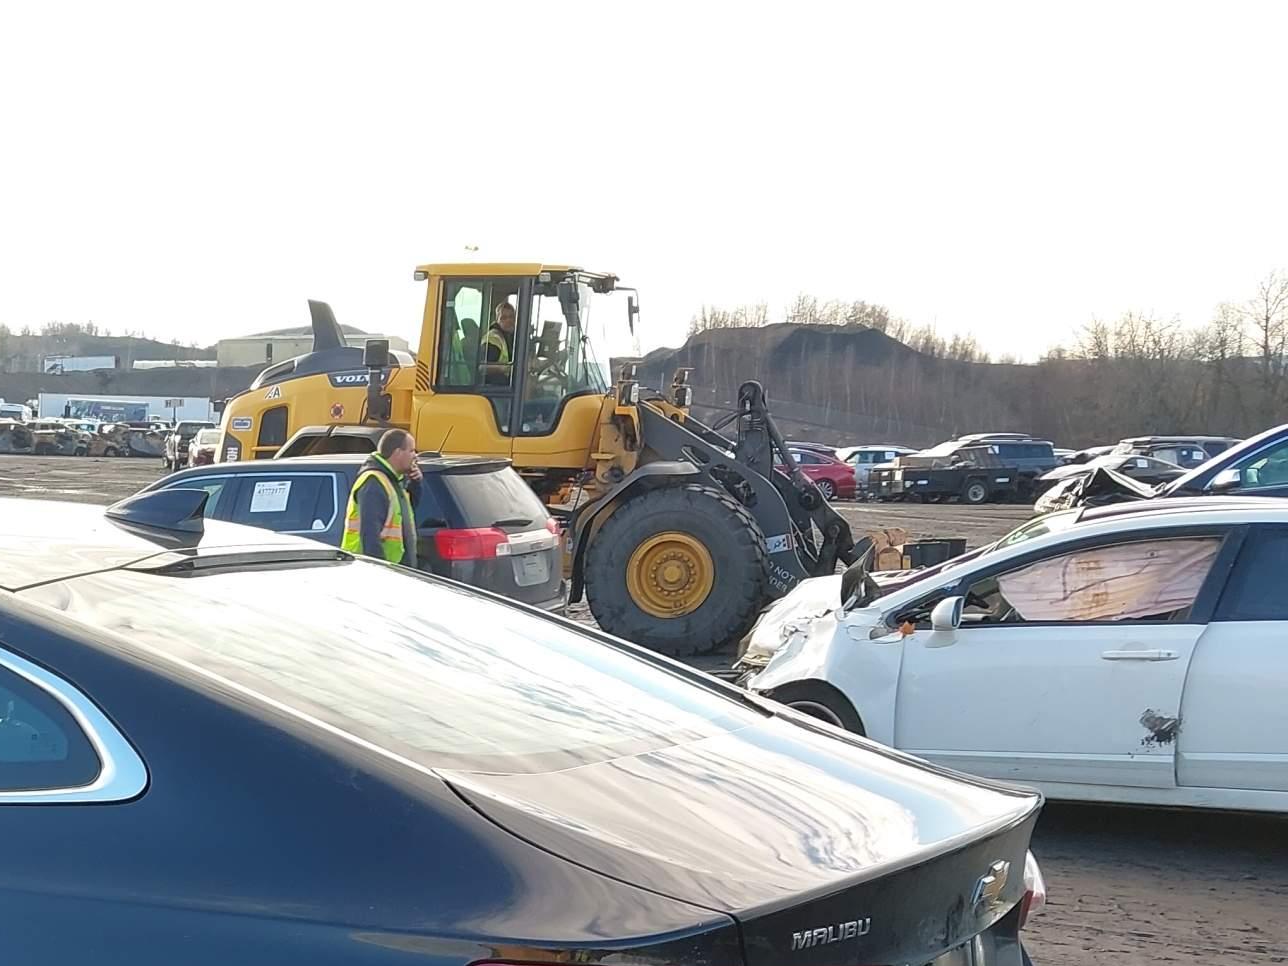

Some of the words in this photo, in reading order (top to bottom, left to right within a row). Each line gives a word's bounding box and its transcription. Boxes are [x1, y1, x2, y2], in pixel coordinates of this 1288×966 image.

[335, 374, 385, 383] VOLV
[774, 566, 795, 583] NOT
[792, 918, 871, 951] MALIBU
